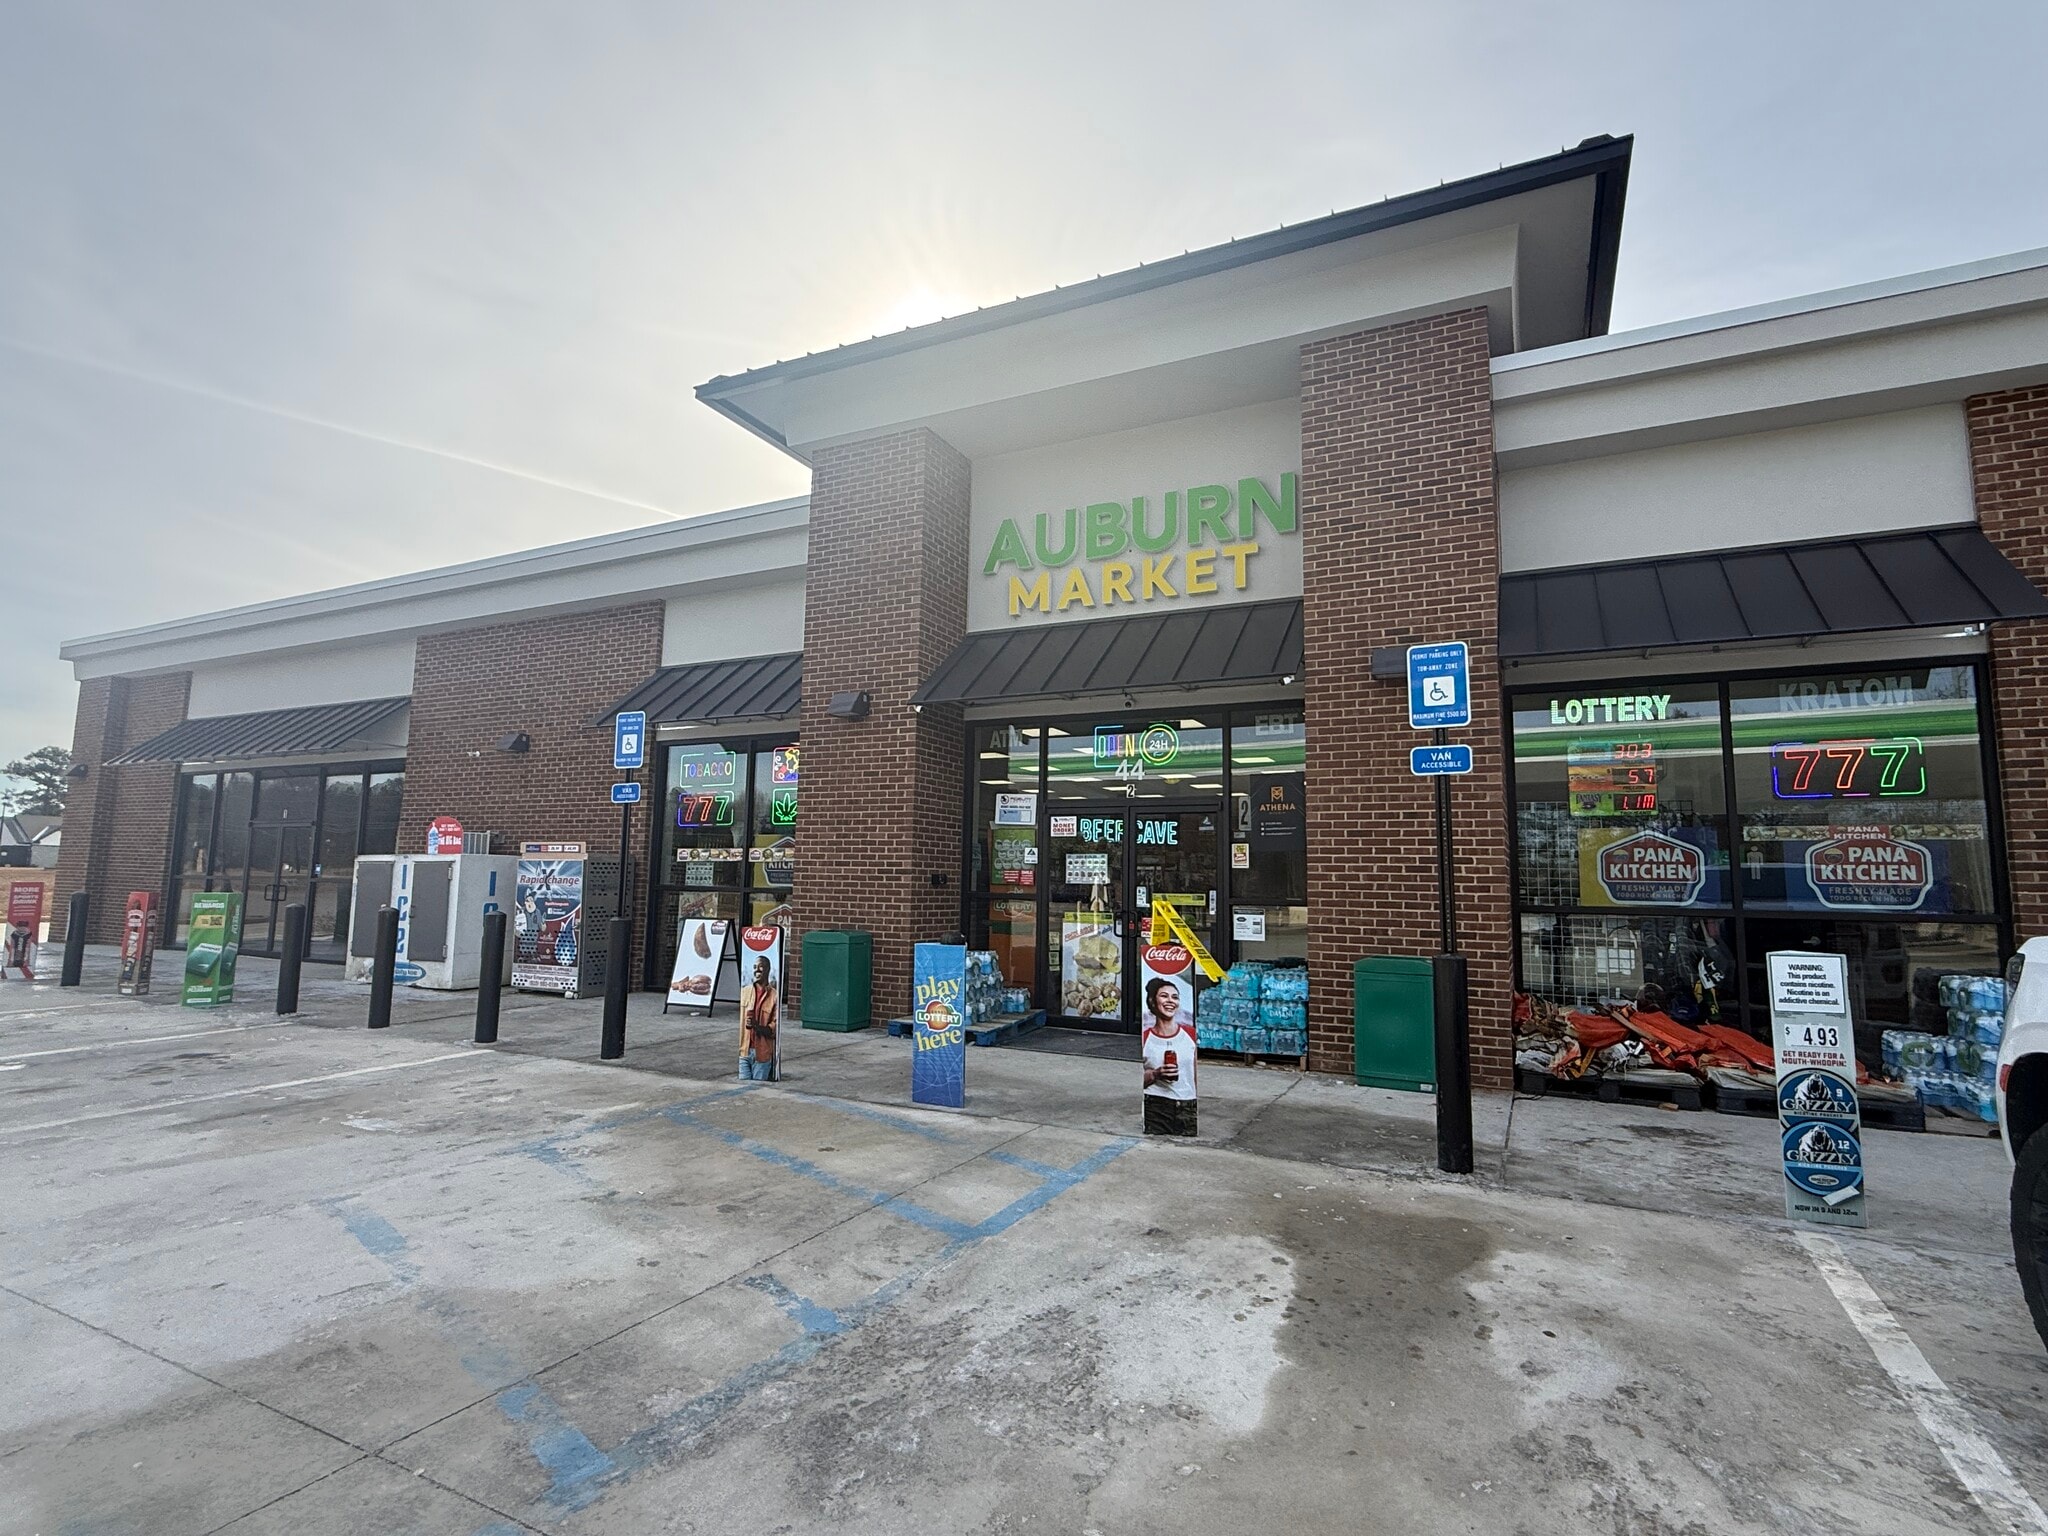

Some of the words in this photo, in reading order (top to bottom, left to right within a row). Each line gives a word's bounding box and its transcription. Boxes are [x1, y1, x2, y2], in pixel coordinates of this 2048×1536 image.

[983, 471, 1297, 575] AUBURN
[1008, 543, 1259, 616] MARKET
[1778, 676, 1914, 711] KRATOM
[1550, 694, 1671, 724] LOTTERY
[1255, 713, 1298, 736] EBT
[989, 724, 1022, 748] ATM
[1098, 734, 1135, 758] OPEN
[1149, 740, 1168, 751] 24H
[1614, 744, 1652, 759] 303
[1431, 752, 1452, 761] VAN
[684, 761, 732, 777] TOBACCO
[1115, 759, 1145, 781] 44
[1784, 745, 1909, 789] 777
[1127, 785, 1134, 798] 2
[683, 796, 730, 821] 777
[1240, 801, 1248, 825] 2
[1260, 803, 1296, 811] ATHENA
[1633, 847, 1685, 862] PANA
[1848, 847, 1908, 862] PANA
[768, 861, 793, 869] KITCH
[1610, 863, 1691, 879] KITCHEN
[1821, 864, 1917, 880] KITCHEN
[1876, 887, 1912, 895] MADE
[1802, 973, 1827, 981] product
[916, 976, 962, 1006] play
[1786, 988, 1813, 996] Nicotine
[1808, 998, 1840, 1006] chemical.
[918, 1013, 960, 1023] LOTTERY
[1269, 1010, 1294, 1019] DASANI
[915, 1029, 963, 1052] here
[1785, 1026, 1791, 1035] $
[1803, 1027, 1838, 1047] 4.93
[1798, 1051, 1821, 1059] READY
[1835, 1088, 1843, 1097] 9
[1782, 1098, 1853, 1113] GRIZZLY
[1837, 1140, 1850, 1150] 12
[1786, 1149, 1858, 1165] GRIZZLY
[1795, 1204, 1810, 1212] NOW
